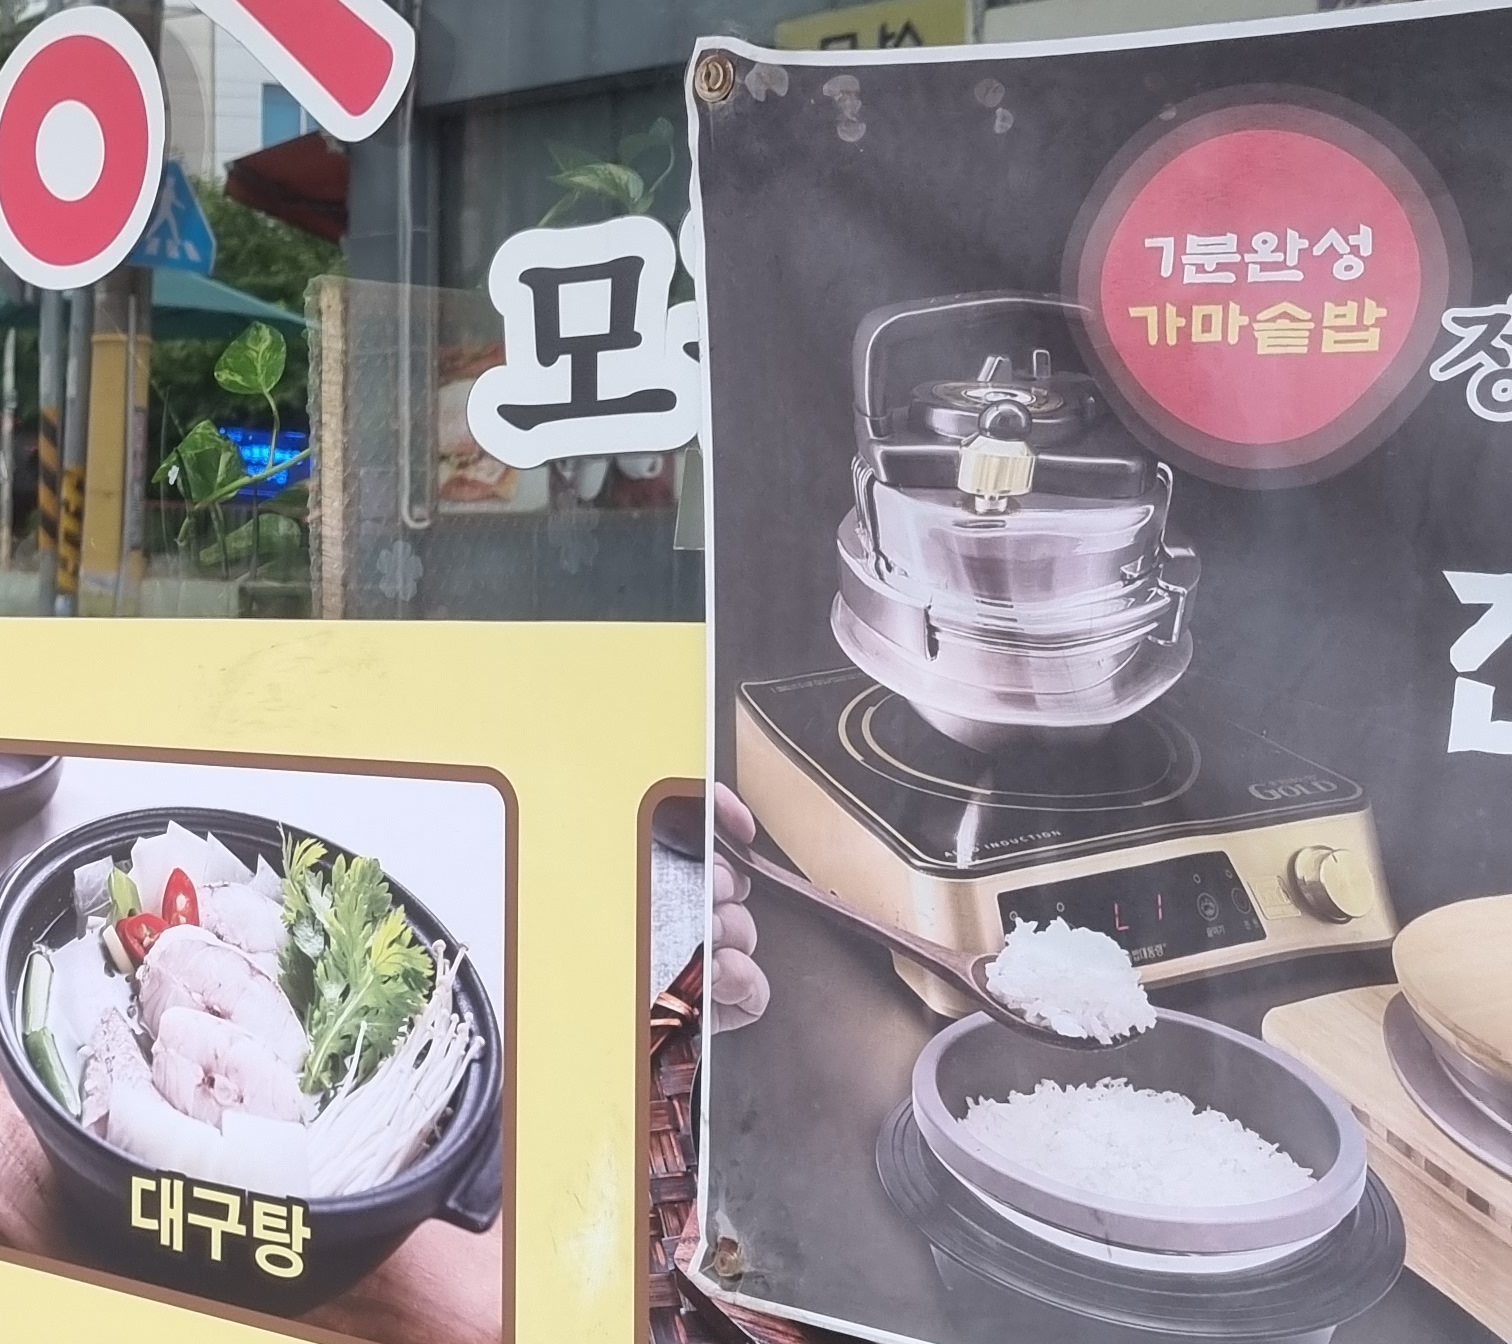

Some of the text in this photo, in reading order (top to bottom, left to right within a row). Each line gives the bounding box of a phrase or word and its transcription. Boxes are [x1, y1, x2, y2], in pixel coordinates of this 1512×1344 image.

[497, 254, 700, 432] 모
[1128, 297, 1389, 357] 가마솥밥
[1248, 779, 1338, 802] GOLD
[984, 829, 1062, 851] INDUCTION
[130, 1175, 313, 1281] 대구탕
